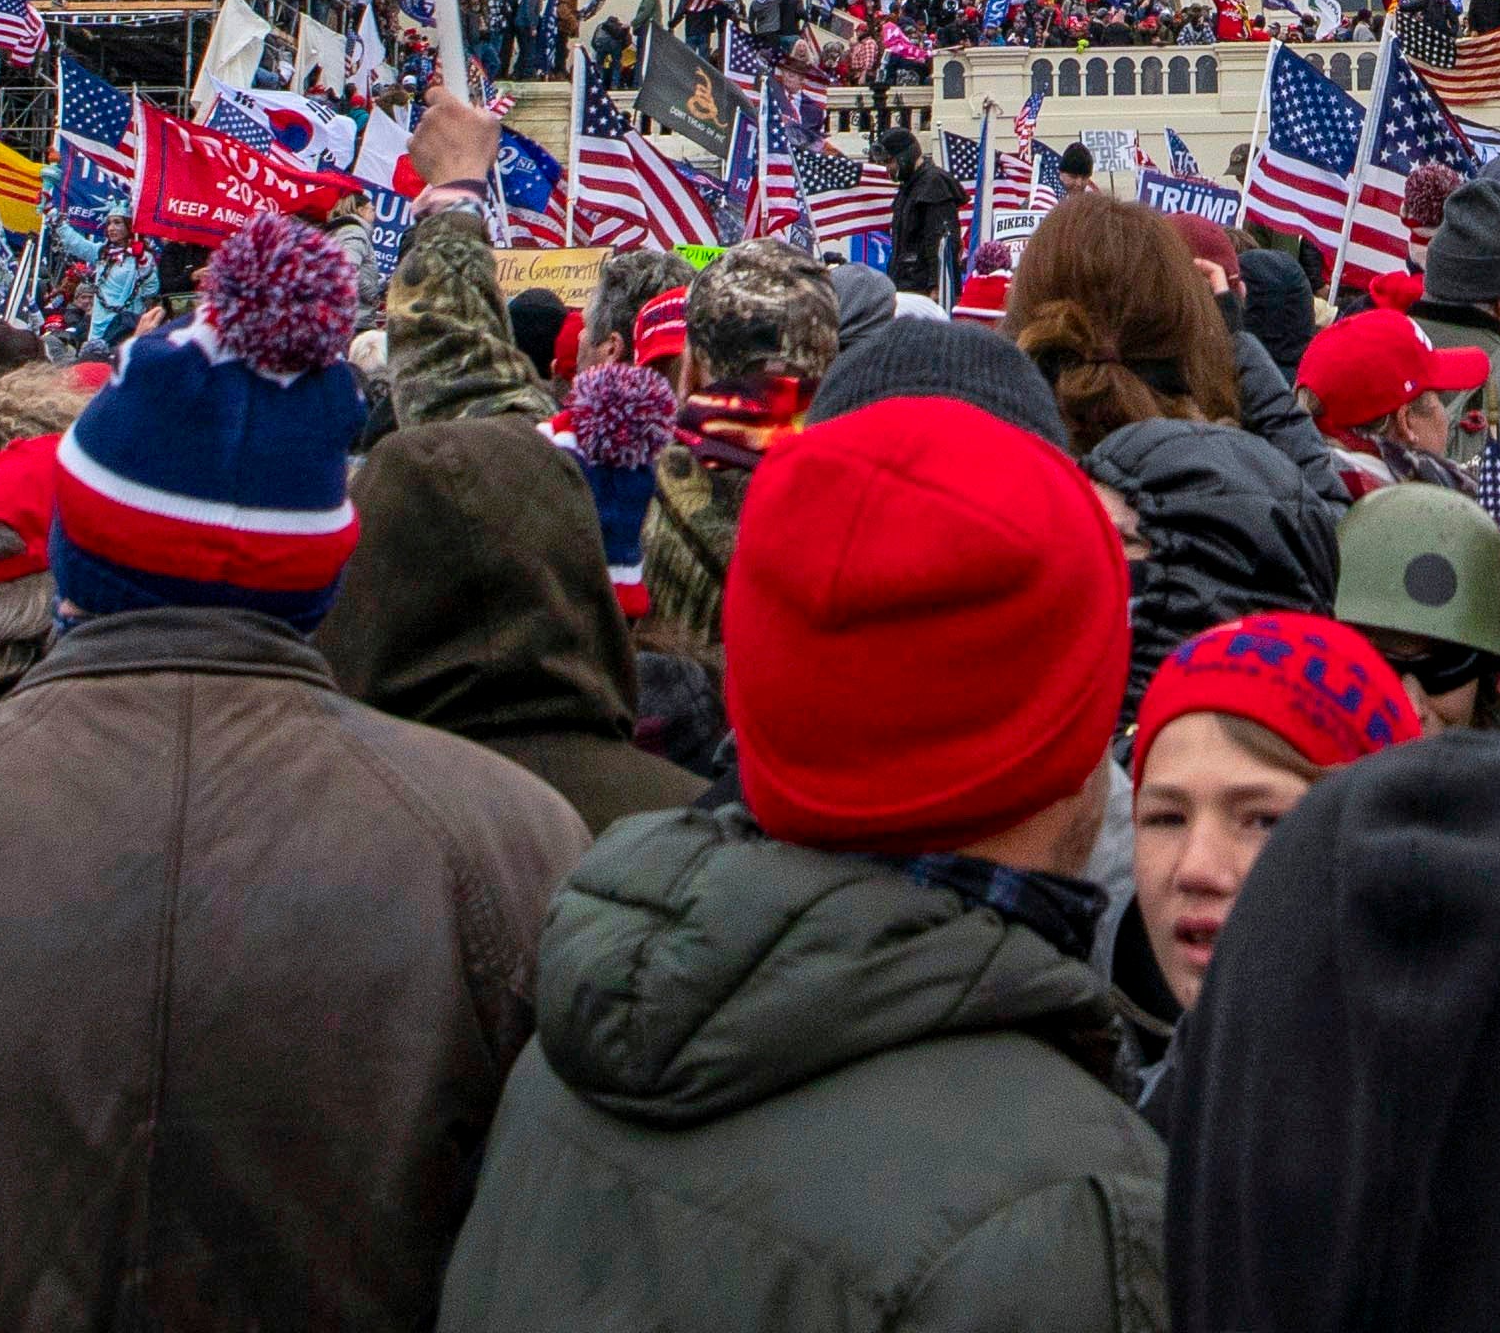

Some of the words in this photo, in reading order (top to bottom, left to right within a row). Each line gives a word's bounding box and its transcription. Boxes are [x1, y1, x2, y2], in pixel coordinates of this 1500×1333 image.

[1084, 131, 1129, 147] SEND
[500, 145, 537, 175] 2ND
[68, 204, 96, 219] KEEP
[167, 199, 209, 218] KEEP
[1147, 181, 1241, 226] TRUMP
[996, 215, 1036, 233] BIKERS
[499, 255, 526, 282] The
